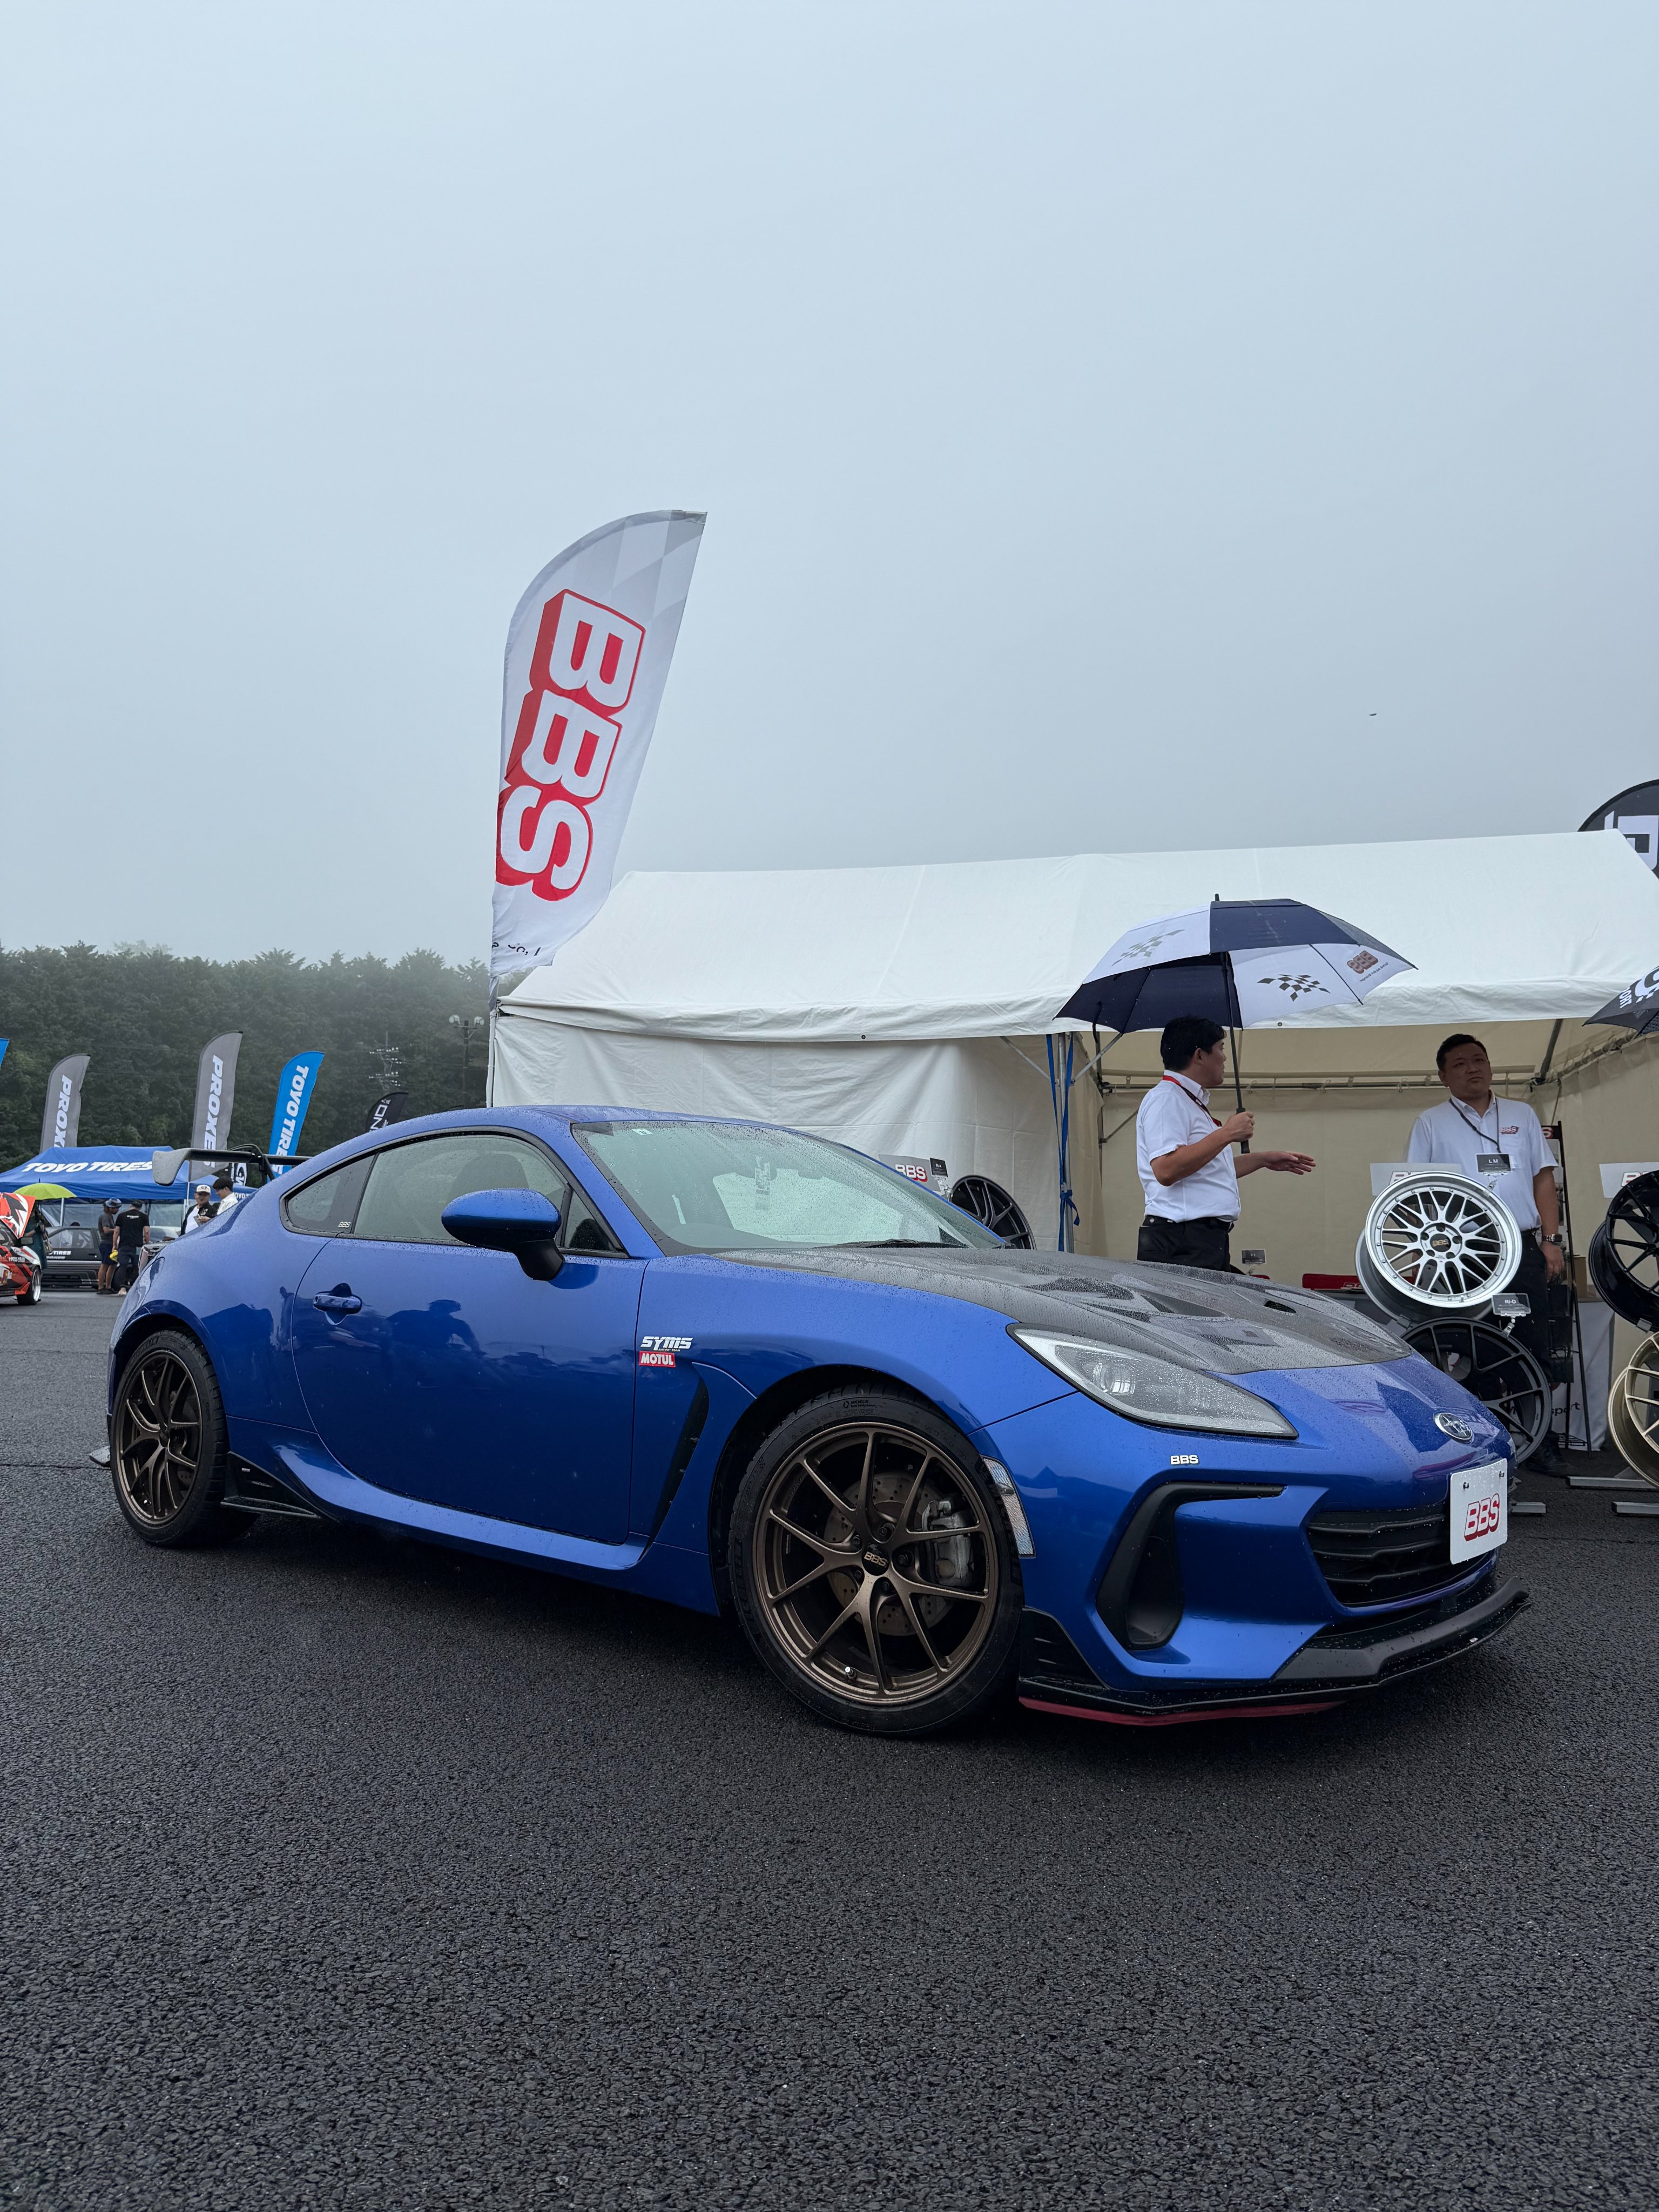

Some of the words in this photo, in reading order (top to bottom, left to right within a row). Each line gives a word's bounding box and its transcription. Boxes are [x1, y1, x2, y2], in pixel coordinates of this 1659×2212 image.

[496, 589, 646, 901] BBS
[286, 1065, 309, 1117] TOYO
[22, 1162, 89, 1173] TOYO
[86, 1161, 153, 1172] TIRES
[1432, 1239, 1449, 1247] BBS
[640, 1353, 674, 1365] MOTUL
[1170, 1454, 1199, 1465] BBS
[1464, 1493, 1500, 1542] BBS
[864, 1552, 887, 1566] BBS
